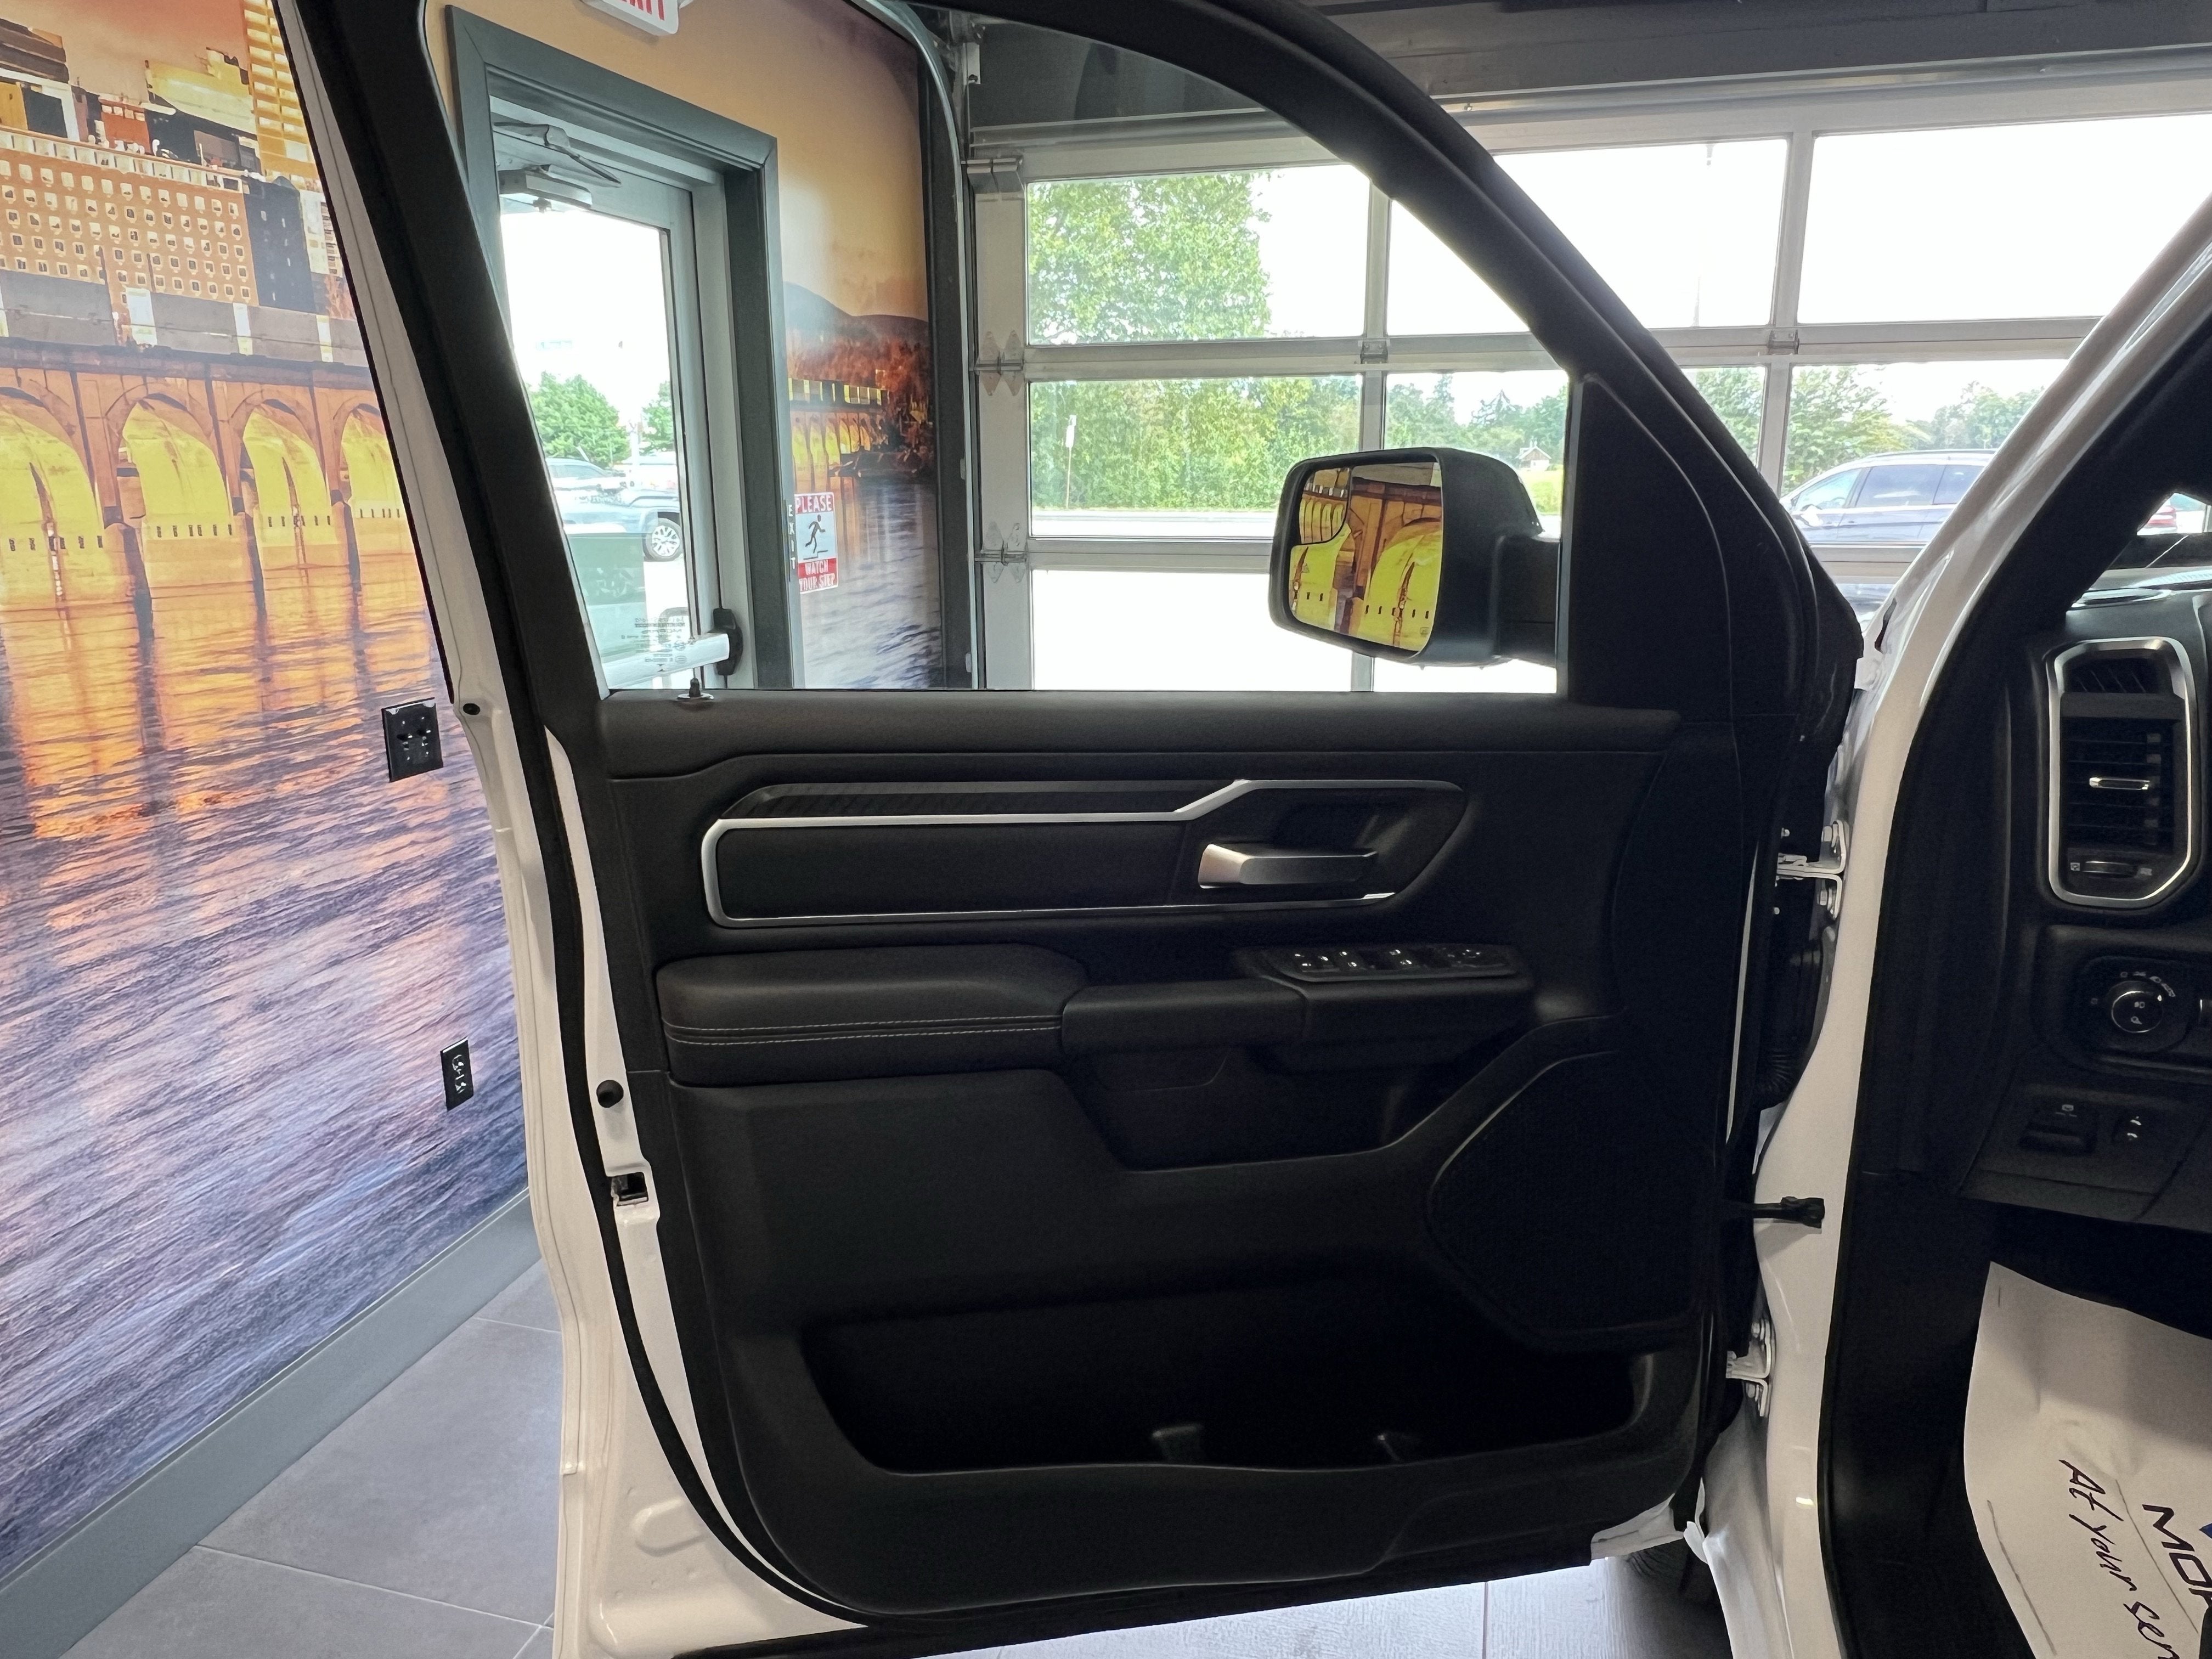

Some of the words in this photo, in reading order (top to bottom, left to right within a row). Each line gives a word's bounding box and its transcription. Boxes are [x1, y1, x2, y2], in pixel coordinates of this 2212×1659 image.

[794, 495, 833, 514] PLEASE
[804, 559, 828, 575] WATCH
[799, 576, 817, 591] YOUR
[819, 573, 836, 589] STEP
[2058, 1459, 2124, 1522] At
[2069, 1515, 2137, 1591] your
